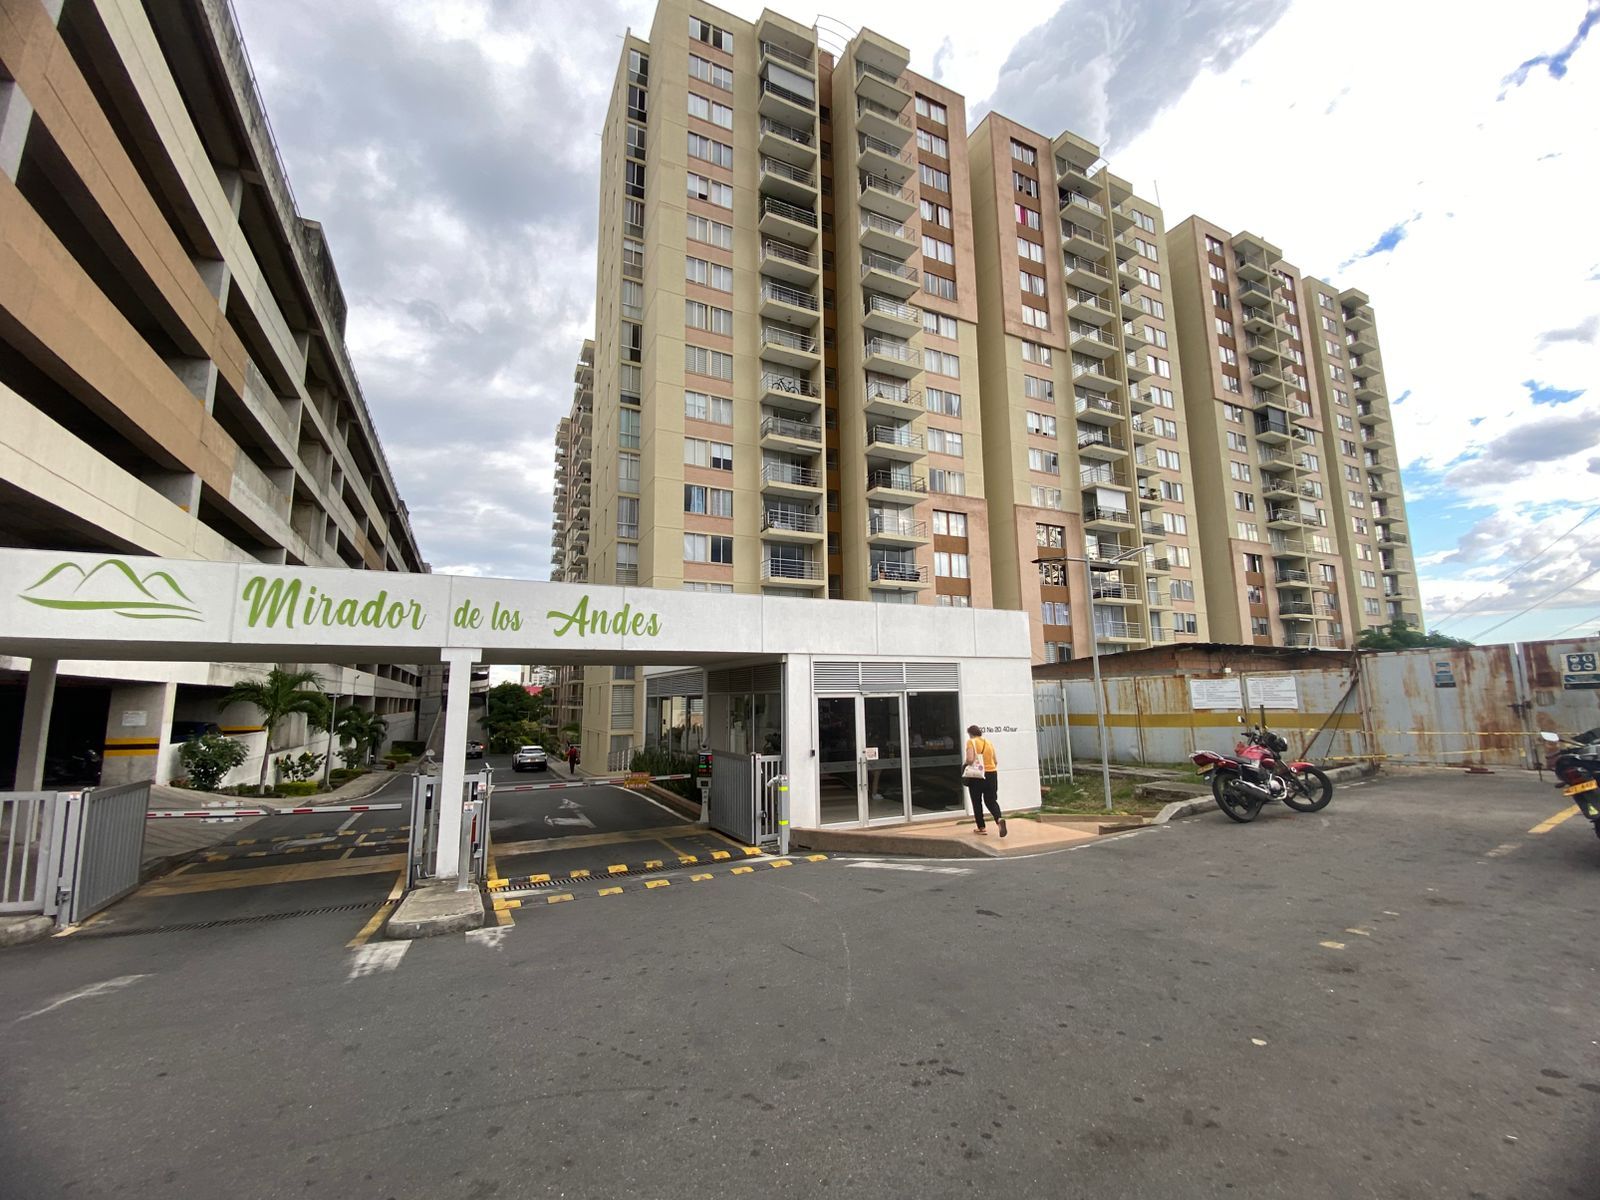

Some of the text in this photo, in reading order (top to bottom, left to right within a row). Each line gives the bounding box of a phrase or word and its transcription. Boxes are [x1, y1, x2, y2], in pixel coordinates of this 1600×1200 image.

[242, 575, 662, 637] Mirador de los Andes
